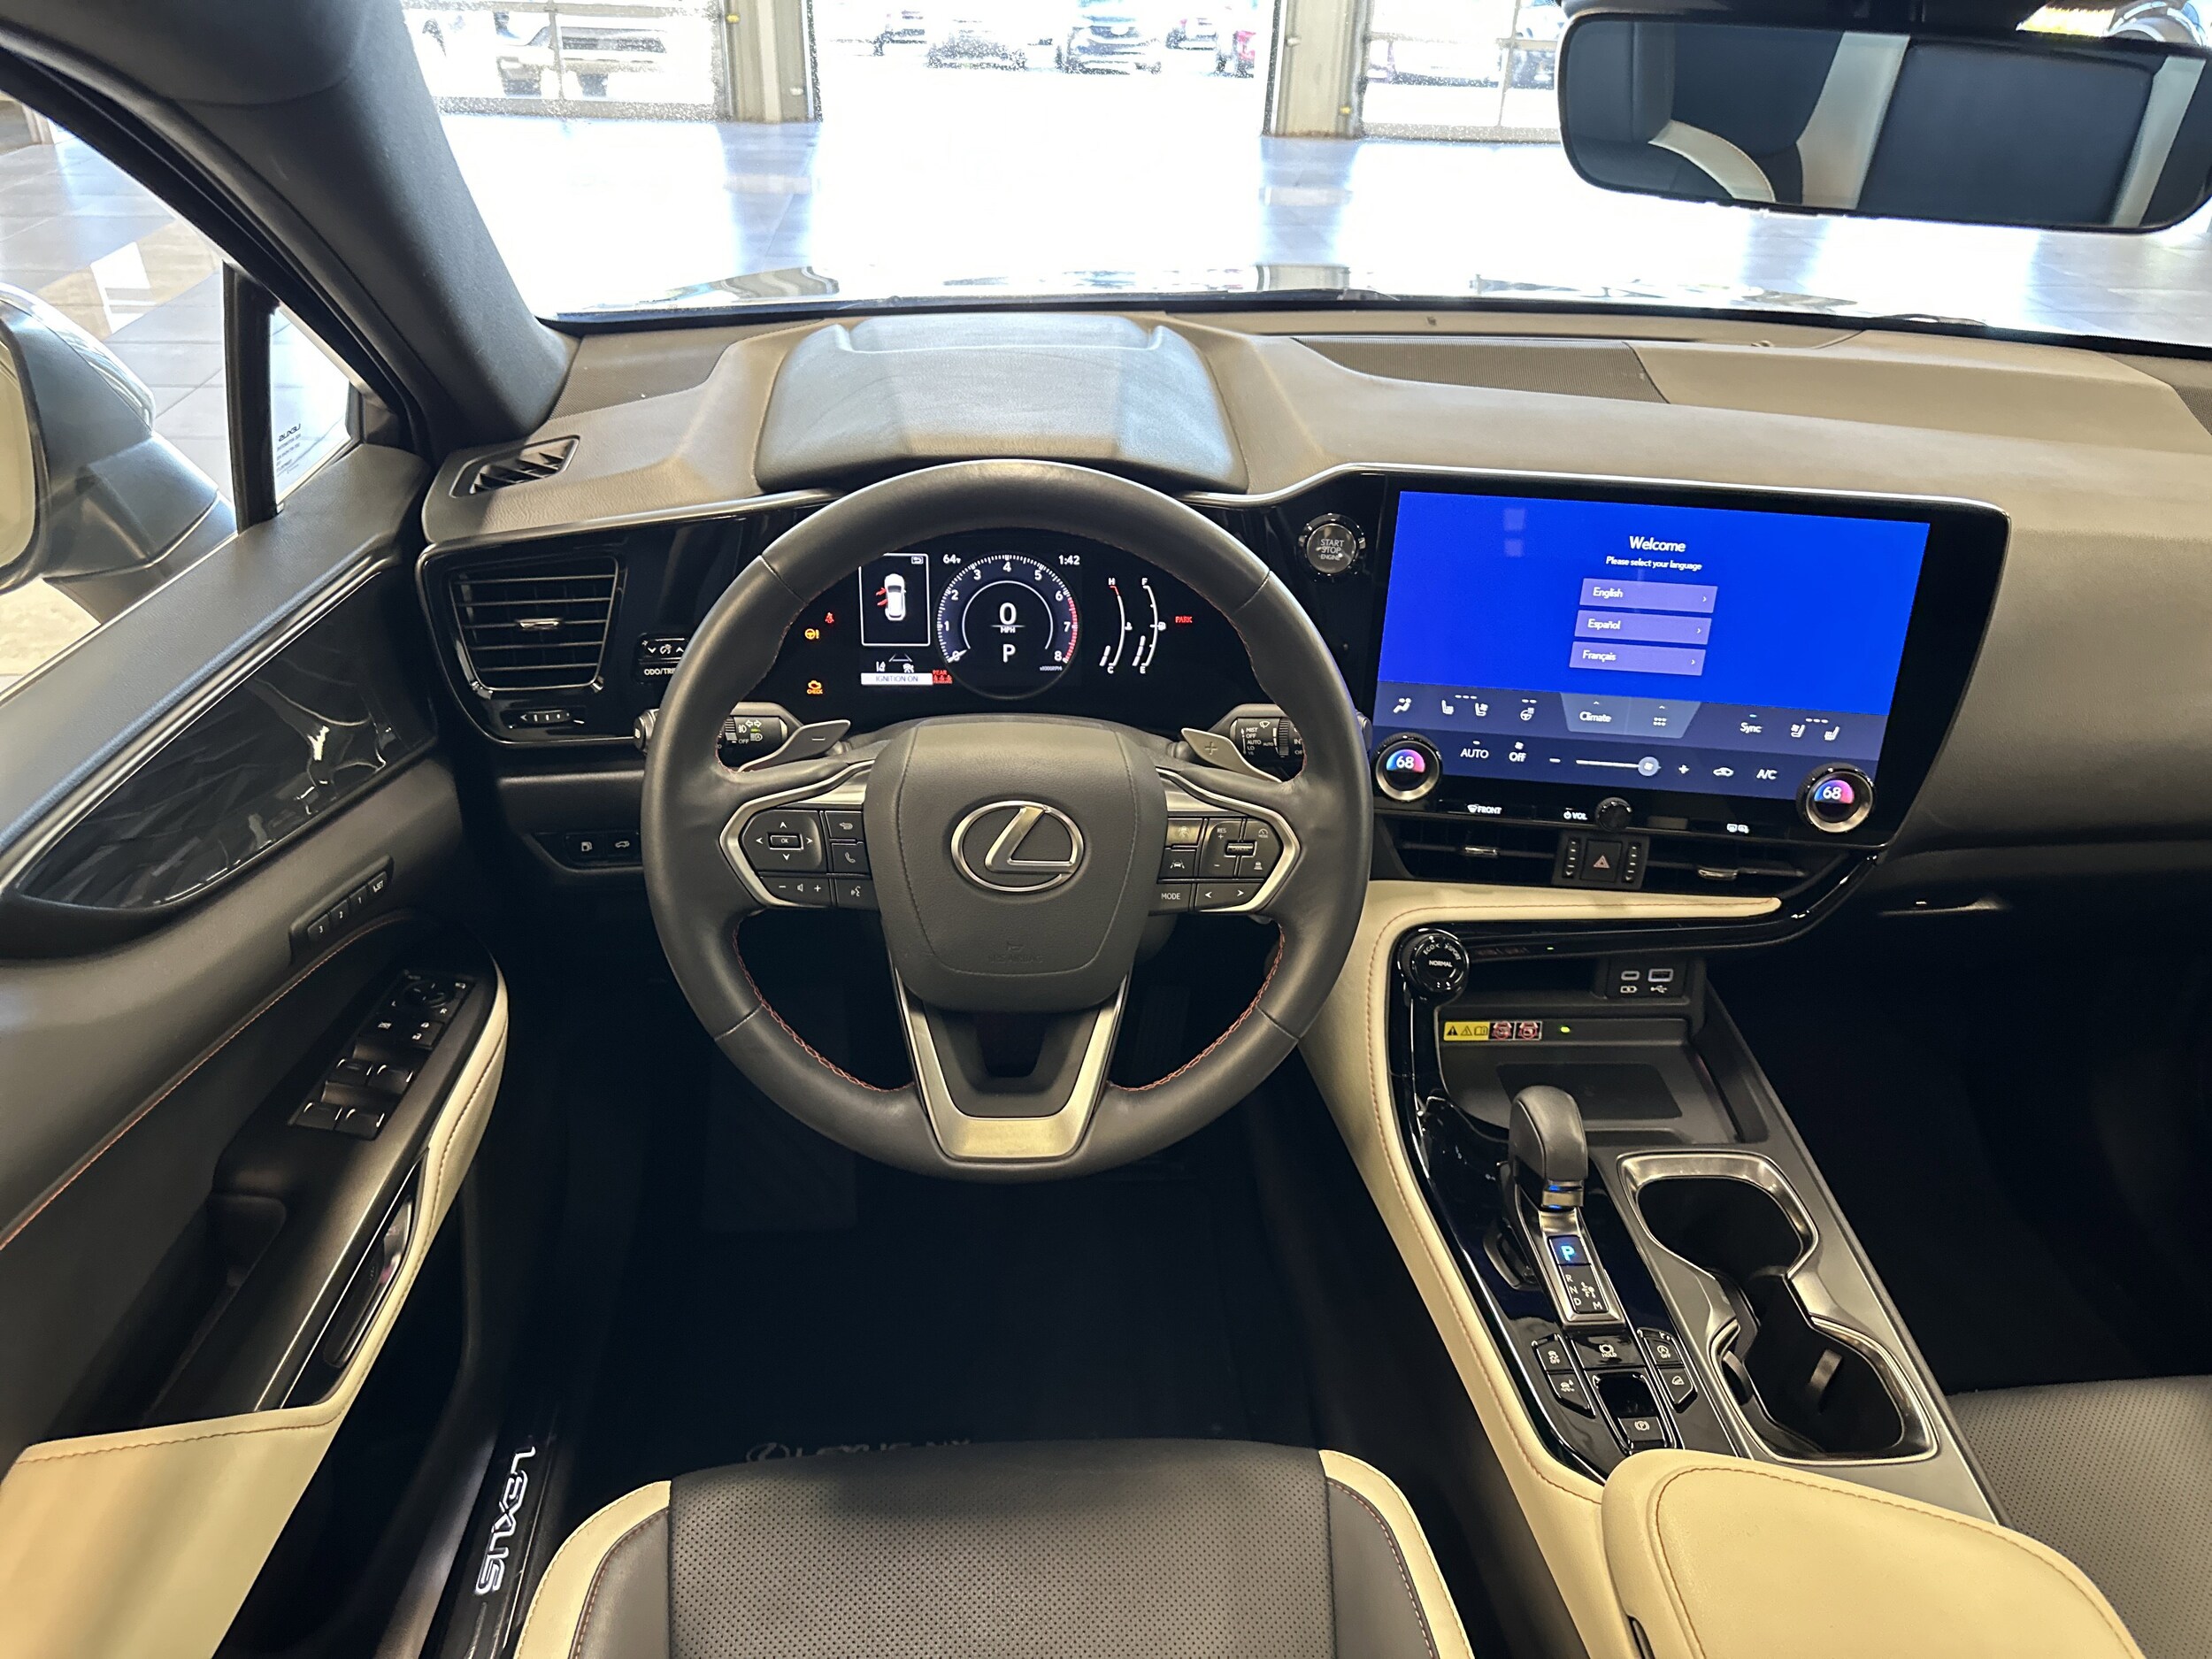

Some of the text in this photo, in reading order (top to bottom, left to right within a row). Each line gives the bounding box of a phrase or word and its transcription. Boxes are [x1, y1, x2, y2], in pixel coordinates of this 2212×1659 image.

[1629, 535, 1686, 552] Welcome
[1059, 555, 1080, 565] 1:42
[1605, 556, 1630, 566] Please
[1631, 557, 1651, 567] select
[1670, 560, 1702, 572] language
[1002, 562, 1011, 572] 4
[973, 570, 981, 580] 3
[1034, 570, 1042, 580] 5
[951, 589, 959, 601] 2
[1055, 590, 1063, 601] 6
[1593, 587, 1623, 599] English
[999, 603, 1017, 625] 0
[944, 620, 949, 631] 1
[1064, 621, 1071, 632] 7
[1587, 618, 1621, 630] Español
[1002, 644, 1016, 663] P
[1054, 650, 1062, 661] 8
[1582, 649, 1617, 662] Français
[1579, 710, 1612, 723] Climate
[1740, 722, 1763, 733] Sync
[1460, 748, 1489, 759] AUTO
[1509, 751, 1526, 763] Off
[1395, 755, 1415, 770] 68
[1756, 769, 1778, 780] A/C
[1822, 786, 1841, 800] 68
[1477, 805, 1502, 815] FRONT
[1423, 944, 1435, 956] ECO
[1428, 959, 1453, 968] NORMAL
[1561, 1245, 1575, 1261] P
[1569, 1286, 1578, 1294] N
[1573, 1297, 1582, 1306] D
[1592, 1301, 1603, 1310] M
[475, 1446, 536, 1594] LEXUS
